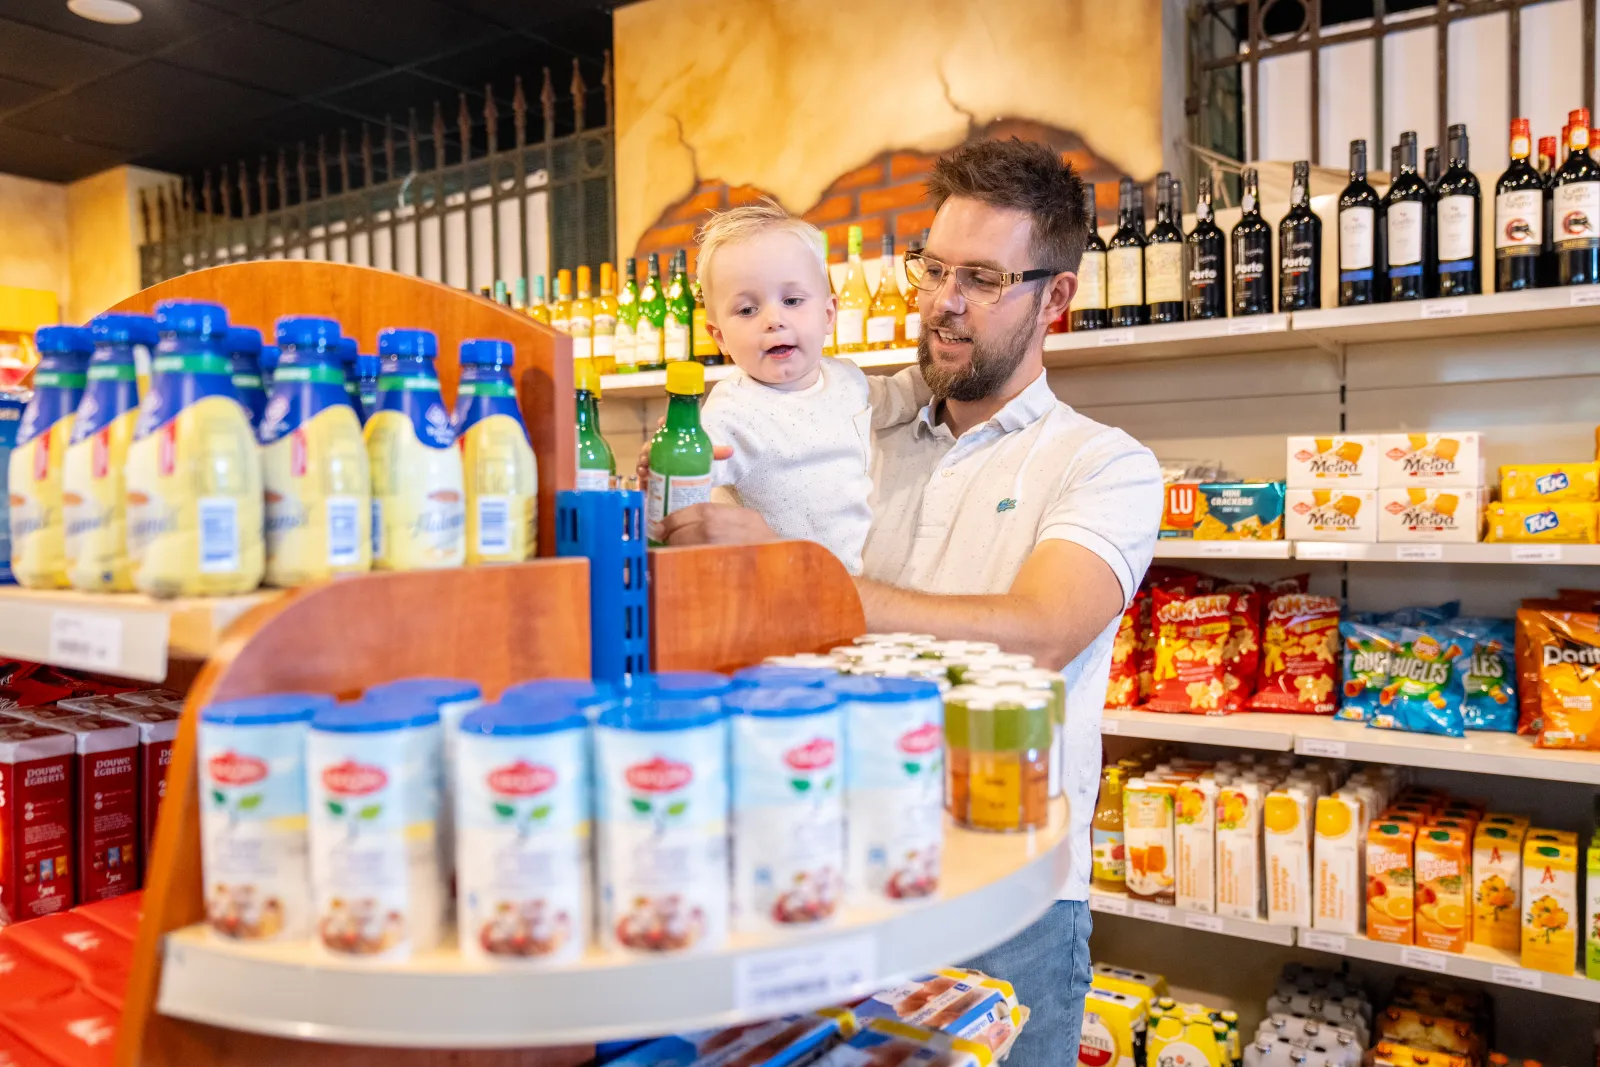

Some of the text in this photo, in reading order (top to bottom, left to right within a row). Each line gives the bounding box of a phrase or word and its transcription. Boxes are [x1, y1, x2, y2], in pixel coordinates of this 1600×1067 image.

[1235, 262, 1264, 274] Porto
[1282, 256, 1312, 268] Porto
[1189, 268, 1218, 280] Porto
[1222, 489, 1242, 498] MINI
[1170, 488, 1193, 514] LU
[1210, 497, 1254, 506] CRACKERS
[1391, 656, 1449, 684] BUGLES
[94, 764, 132, 778] EGBERTS
[24, 773, 65, 787] EGBERTS
[1080, 1034, 1111, 1050] MSTEL
[1081, 1046, 1100, 1057] BIER
